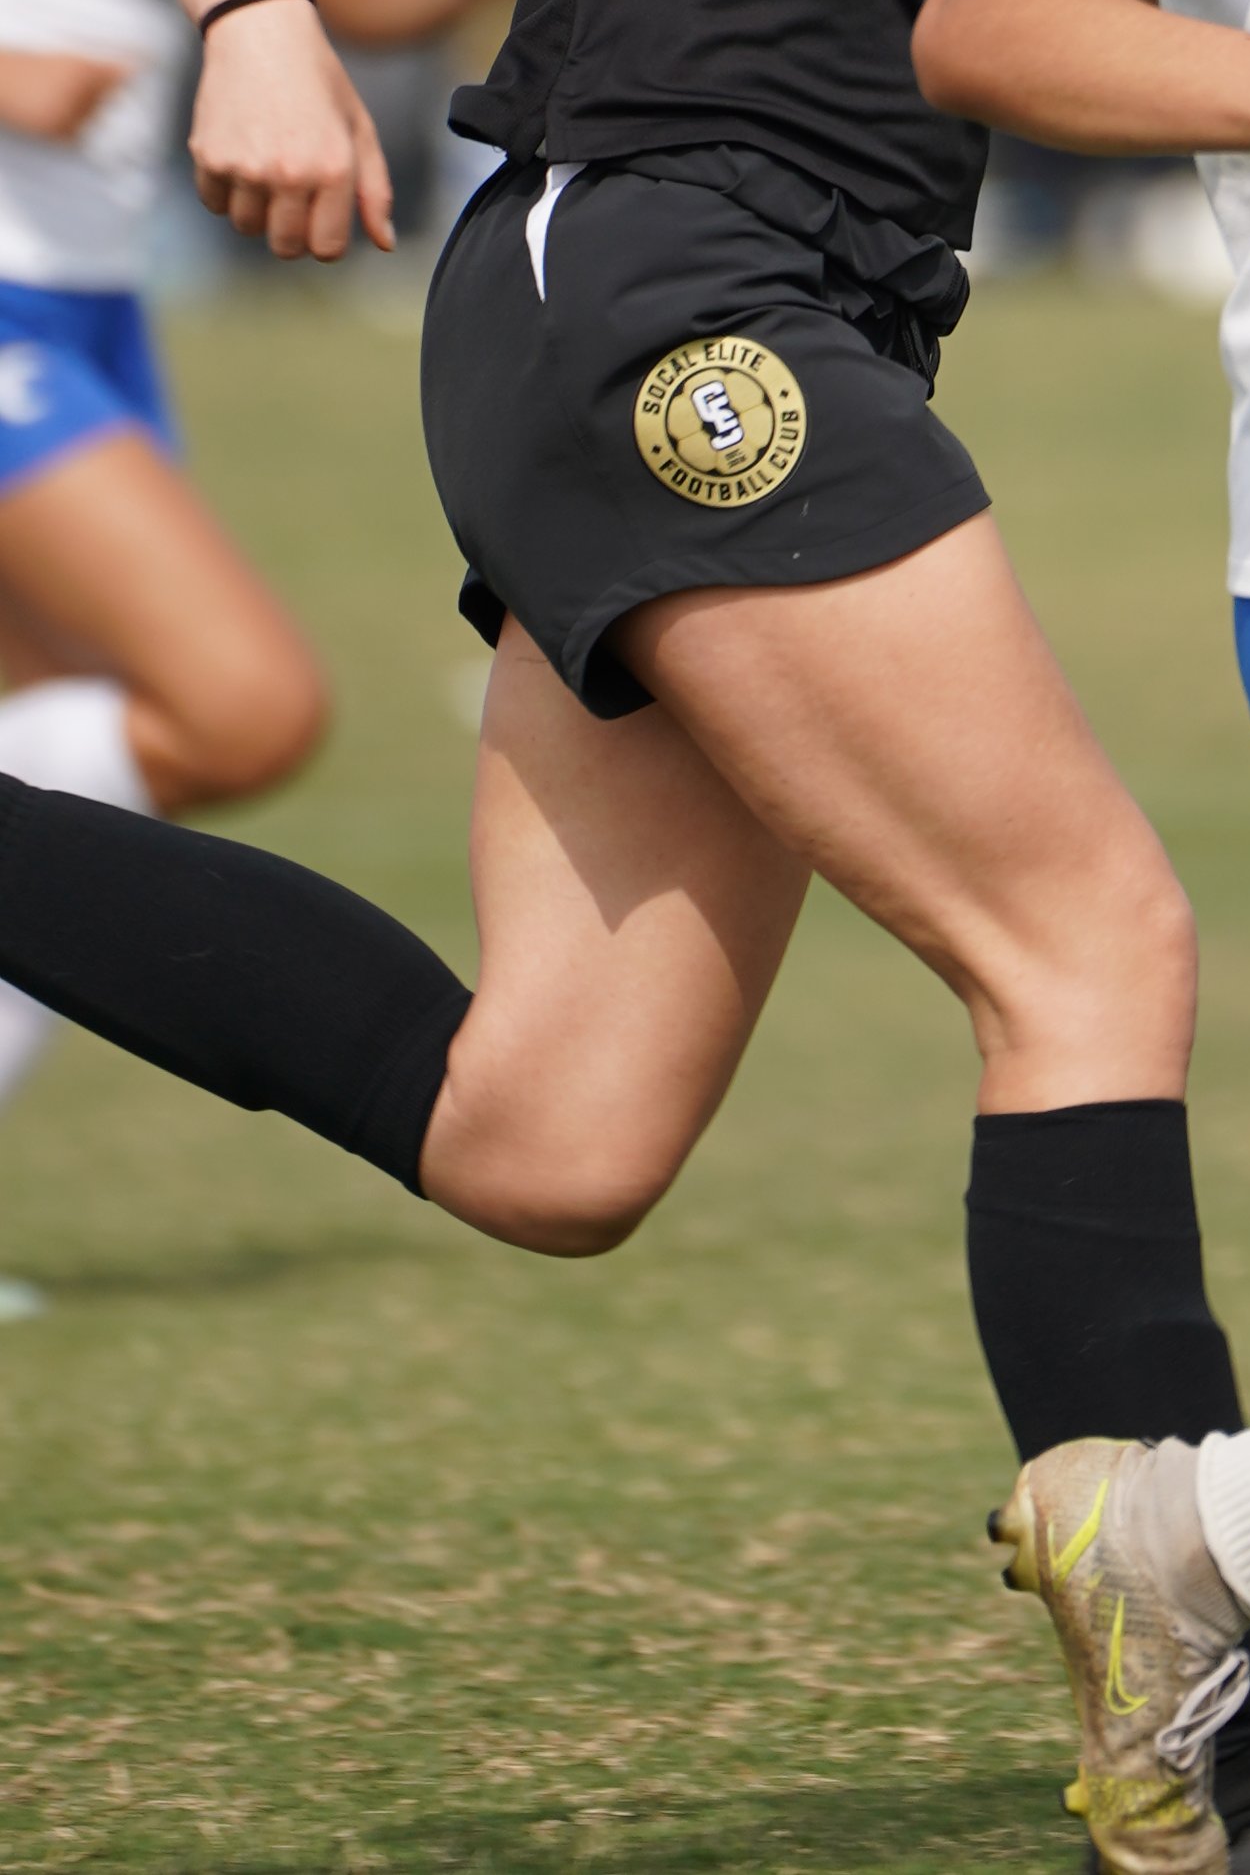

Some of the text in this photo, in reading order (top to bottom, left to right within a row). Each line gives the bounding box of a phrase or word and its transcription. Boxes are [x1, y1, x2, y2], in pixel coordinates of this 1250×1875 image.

[643, 343, 767, 415] SOCAL ELITE
[658, 410, 800, 502] FOOTBALL CLUB
